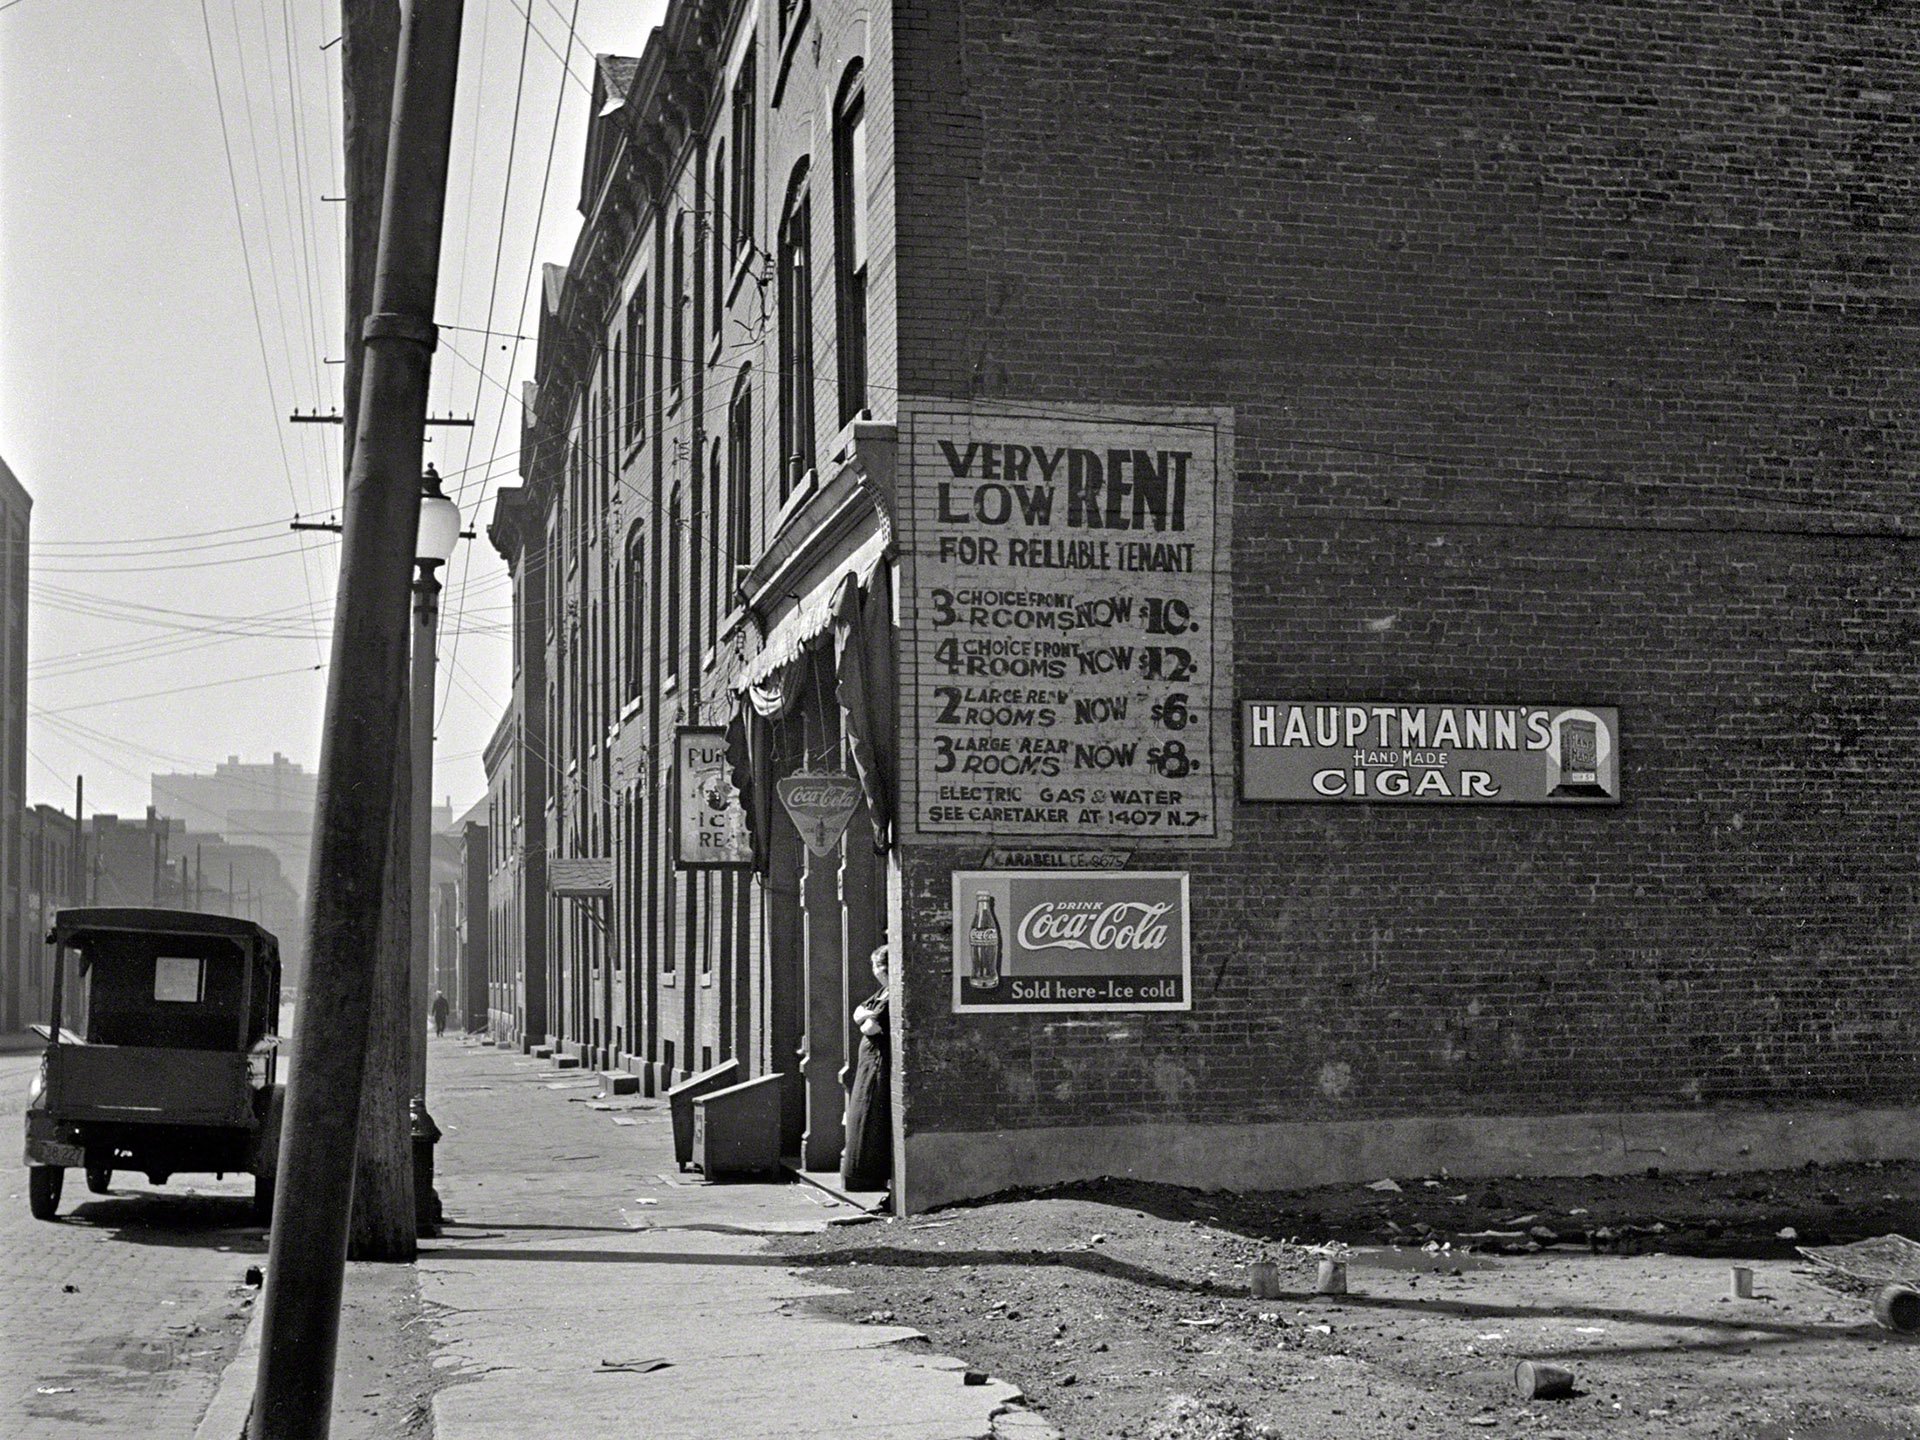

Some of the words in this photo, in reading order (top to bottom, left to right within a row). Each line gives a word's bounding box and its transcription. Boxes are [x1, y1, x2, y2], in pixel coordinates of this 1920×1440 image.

[937, 440, 1067, 481] VERY
[937, 482, 1056, 526] LOW
[1066, 448, 1192, 531] RENT
[939, 536, 998, 565] FOR
[1008, 538, 1111, 570] RELIABLE
[1116, 542, 1195, 572] TENANT
[931, 588, 957, 627] 3
[956, 590, 1027, 606] CHOICE
[1028, 592, 1074, 609] FRONT
[969, 607, 1075, 629] ROOMS
[1075, 597, 1133, 628] NOW
[934, 637, 964, 675] 4
[963, 640, 1031, 656] CHOICE
[1034, 641, 1080, 658] FRONT
[966, 656, 1067, 678] ROOMS
[1078, 646, 1134, 675] NOW
[934, 686, 963, 724] 2
[964, 688, 1022, 704] LARGE
[965, 707, 1056, 727] ROOMS
[1074, 697, 1128, 725] NOW
[1250, 705, 1552, 751] HAUPTMANN'S
[688, 747, 724, 768] PU
[934, 735, 957, 773] 3
[954, 737, 1011, 751] LARGE
[1018, 737, 1068, 753] REAR
[962, 754, 1061, 777] ROOMS
[1074, 742, 1138, 769] NOW
[1353, 749, 1398, 767] HAND
[1403, 750, 1448, 768] MADE
[939, 786, 1022, 802] ELECTRIC
[1039, 788, 1085, 804] GAS
[1091, 790, 1106, 804] &
[1111, 790, 1183, 805] WATER
[1312, 769, 1500, 797] CIGAR
[929, 806, 964, 823] SEE
[969, 807, 1068, 823] CARETAKER
[1078, 809, 1101, 823] AT
[1109, 810, 1161, 826] 1407
[1057, 901, 1104, 911] DRINK
[1017, 902, 1174, 950] Coca-Cola
[1011, 980, 1051, 999] Sold
[1140, 980, 1176, 998] cold
